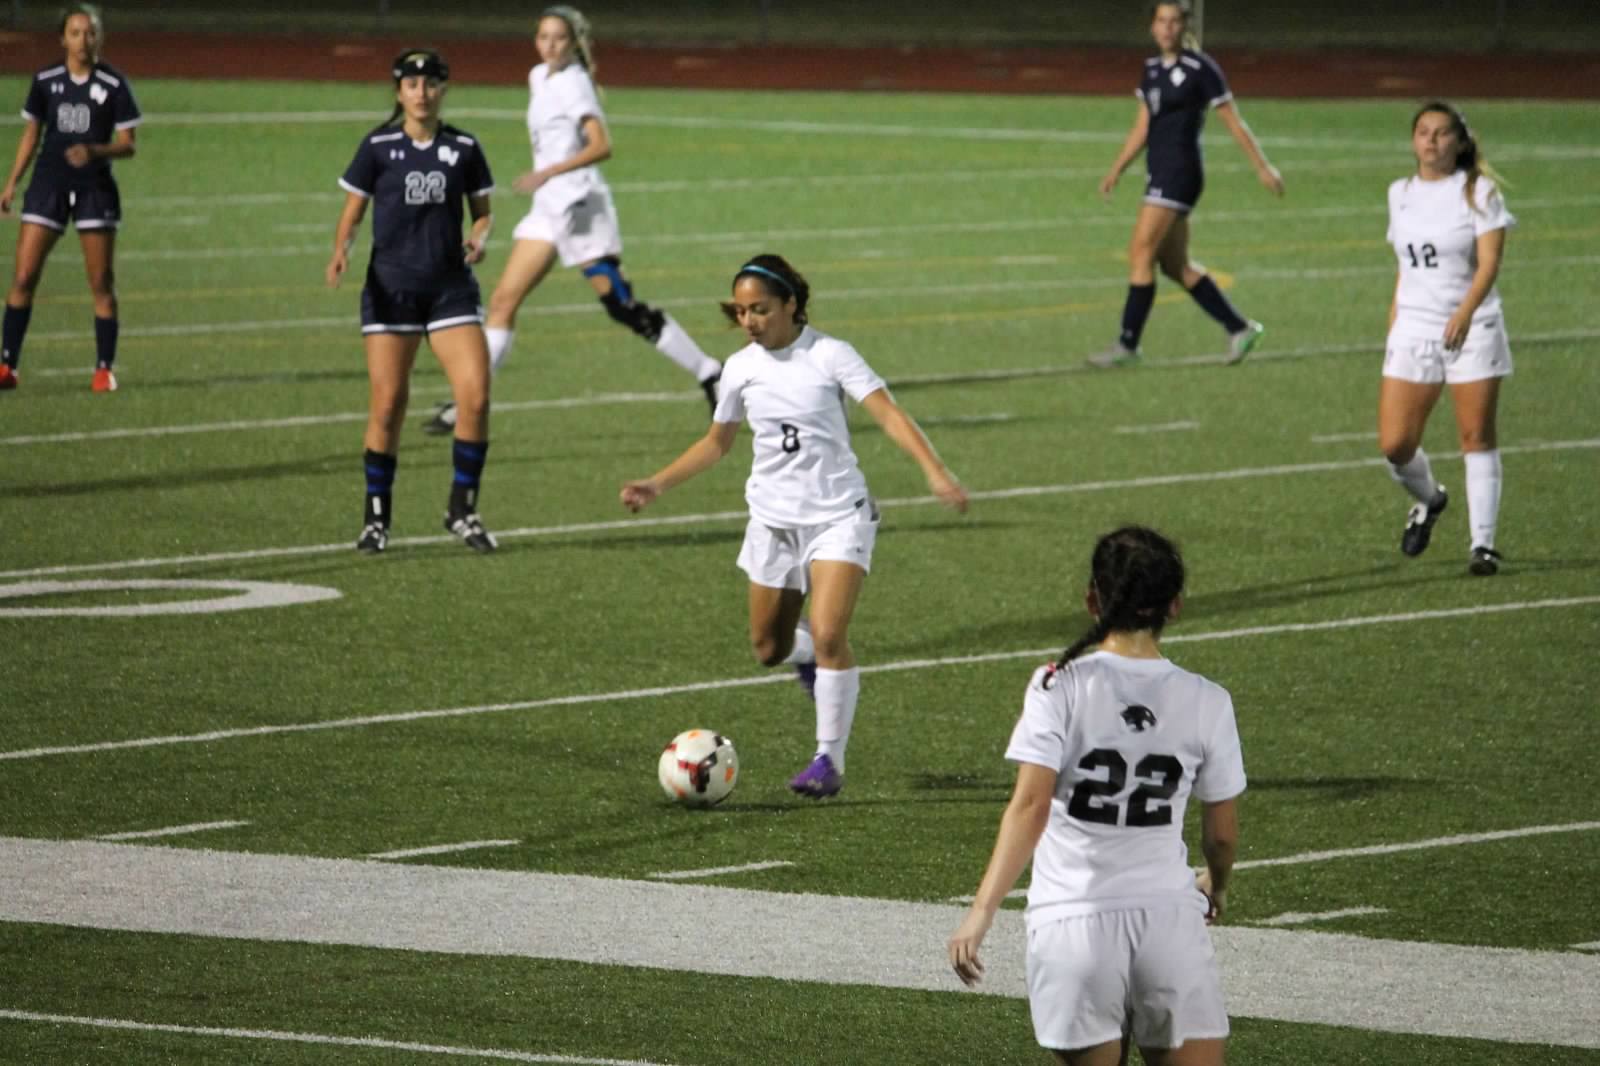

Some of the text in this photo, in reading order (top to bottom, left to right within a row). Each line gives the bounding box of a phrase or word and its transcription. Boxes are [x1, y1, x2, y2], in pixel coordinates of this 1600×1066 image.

[404, 170, 447, 205] 22
[1407, 242, 1439, 268] 12
[781, 422, 801, 454] 8
[1067, 747, 1183, 828] 22
